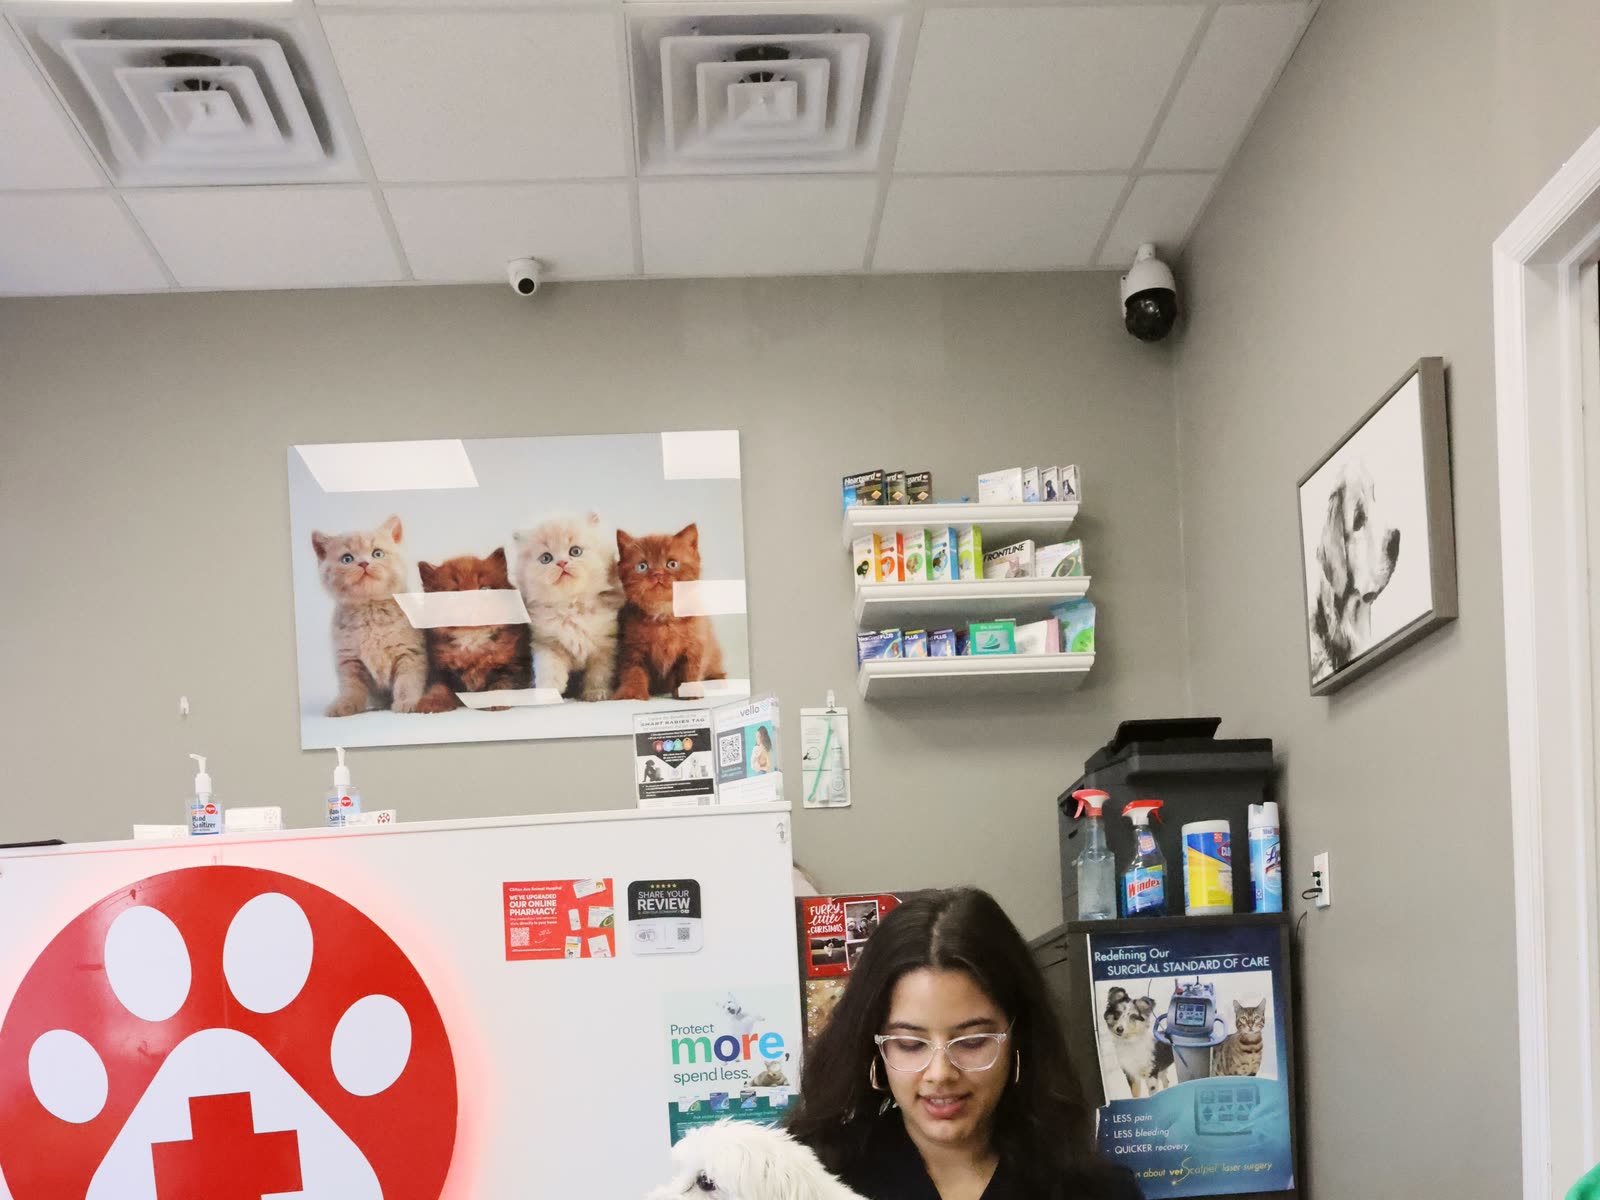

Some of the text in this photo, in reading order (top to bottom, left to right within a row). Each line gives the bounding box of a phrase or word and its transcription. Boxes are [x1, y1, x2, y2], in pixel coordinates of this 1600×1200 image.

[844, 472, 876, 486] Heartgard
[983, 542, 1026, 562] FRONTLINE
[740, 705, 760, 717] vello
[192, 821, 216, 829] Sanitizer
[638, 889, 689, 899] SHARE YOUR
[1128, 878, 1161, 898] Windex
[510, 900, 527, 908] OUR
[637, 897, 690, 911] REVIEW
[810, 902, 840, 915] FURRY
[510, 908, 557, 916] PHARMACY.
[810, 923, 843, 934] CHRISTMAS
[1094, 948, 1170, 962] Redefining Our
[1107, 956, 1270, 976] SURGICAL STANDARD OF CARE
[670, 1023, 714, 1036] Protect
[671, 1031, 790, 1065] more,
[673, 1066, 752, 1086] spend less.
[1112, 1114, 1152, 1124] LESS pain
[1113, 1128, 1170, 1139] LESS bleeding
[1114, 1143, 1190, 1155] QUICKER recovery
[1143, 1168, 1166, 1178] about
[1222, 1164, 1241, 1172] laser
[1244, 1161, 1273, 1172] surgery
